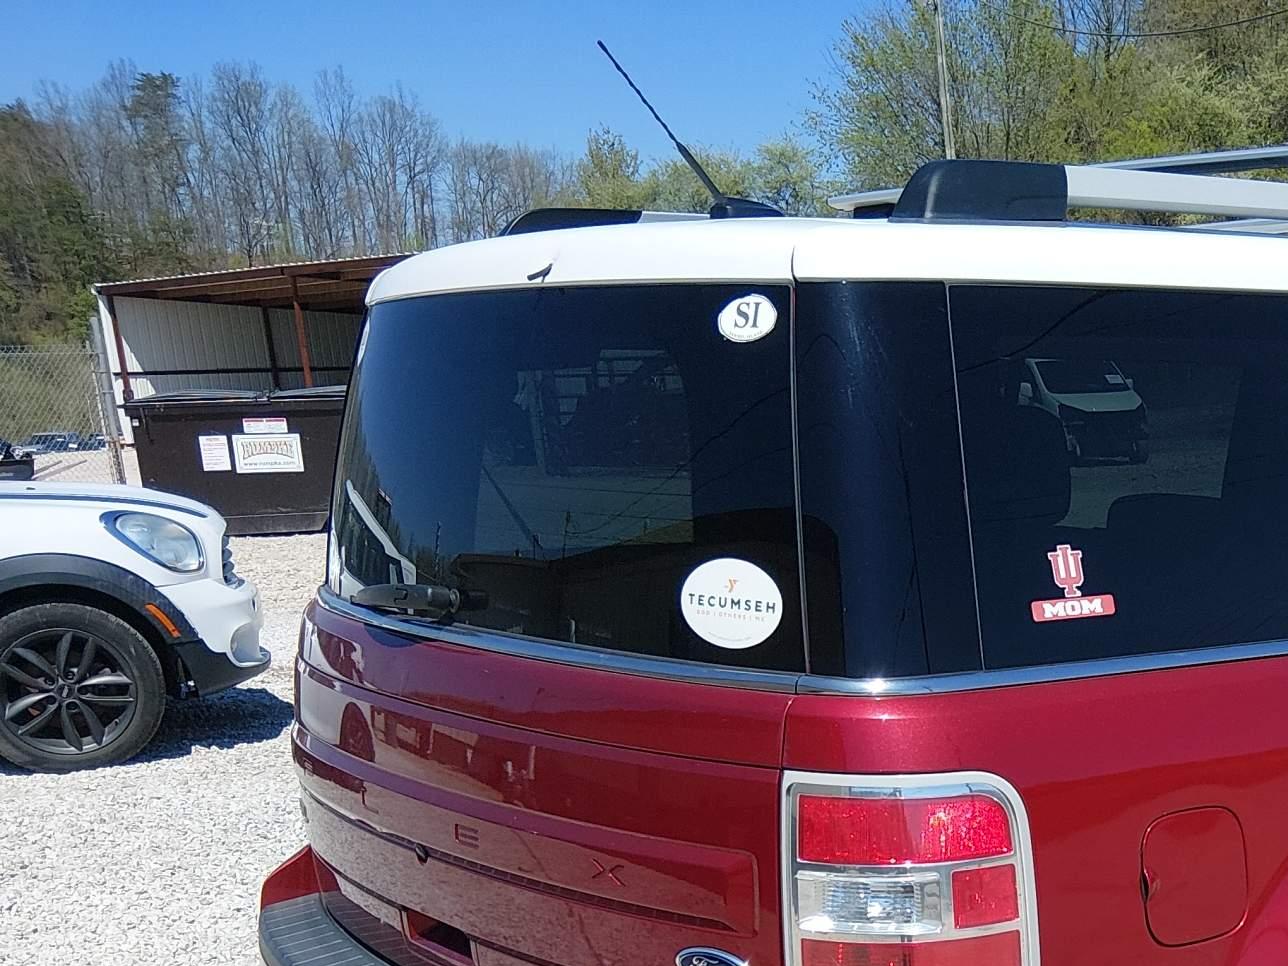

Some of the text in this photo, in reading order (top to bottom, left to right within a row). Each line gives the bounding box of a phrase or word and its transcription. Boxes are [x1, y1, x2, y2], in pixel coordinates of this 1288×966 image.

[734, 301, 762, 329] SI
[688, 592, 776, 615] TECUMSEH
[1042, 598, 1104, 618] MOM
